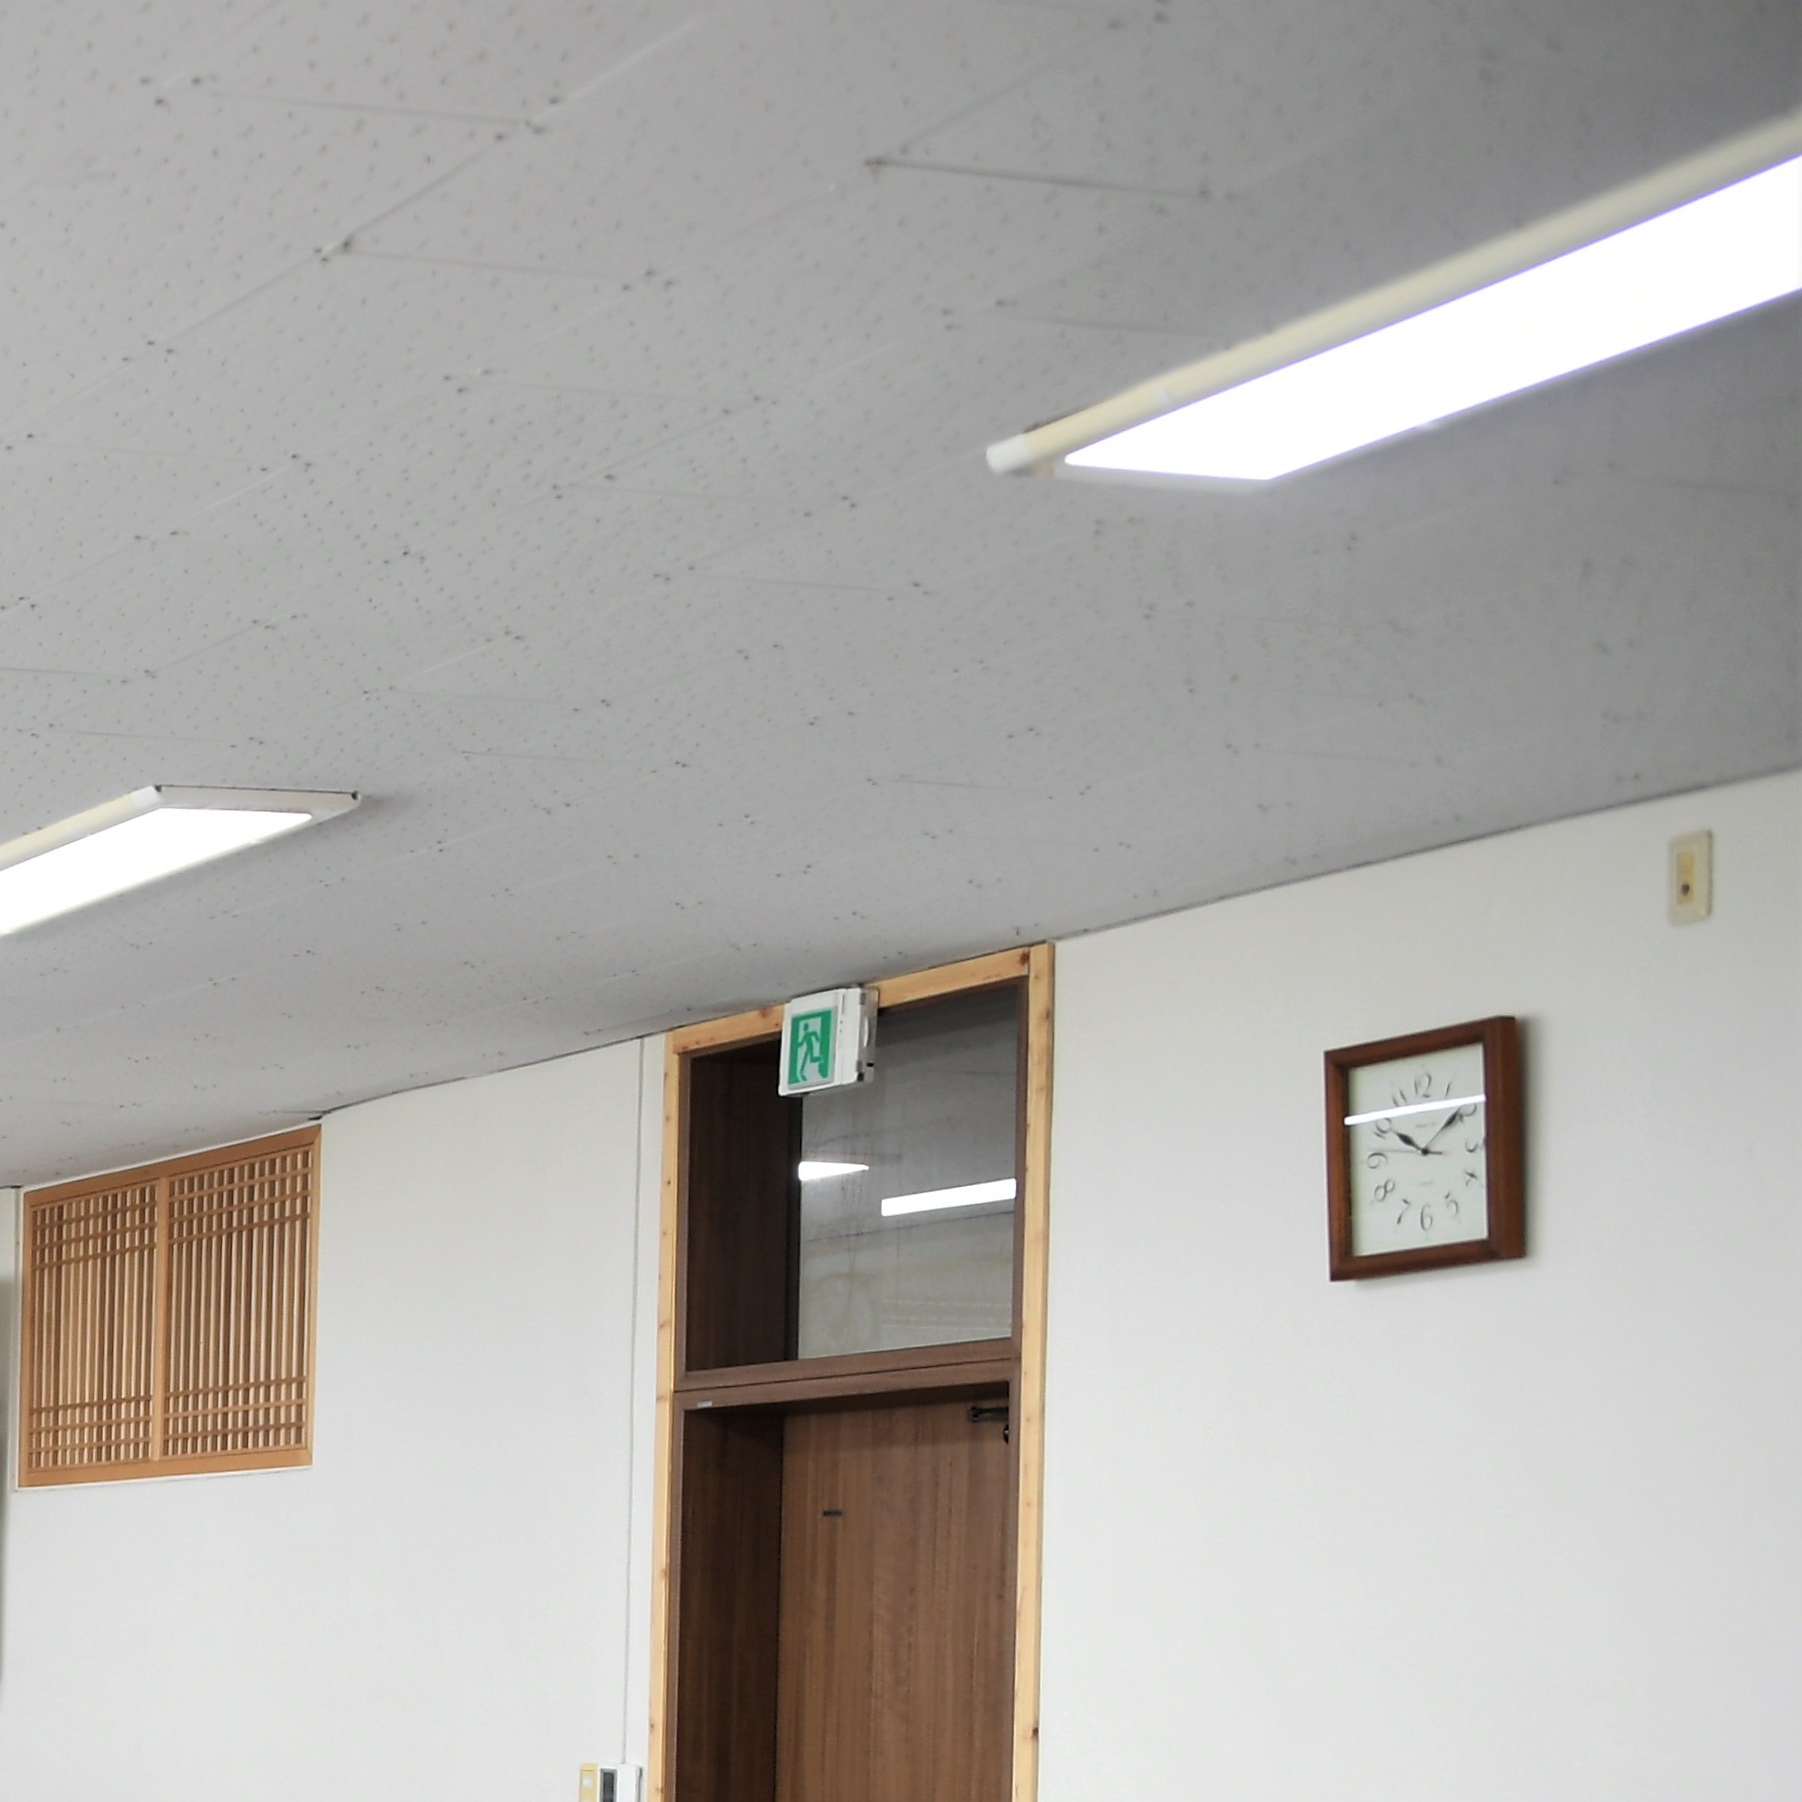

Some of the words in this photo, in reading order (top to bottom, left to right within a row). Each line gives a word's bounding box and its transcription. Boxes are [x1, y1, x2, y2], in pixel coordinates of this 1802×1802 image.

[1413, 1072, 1433, 1099] 12
[1373, 1117, 1394, 1140] 10
[1366, 1151, 1389, 1170] 9
[1373, 1178, 1397, 1203] 8
[1396, 1197, 1413, 1225] 7
[1419, 1203, 1434, 1232] 6
